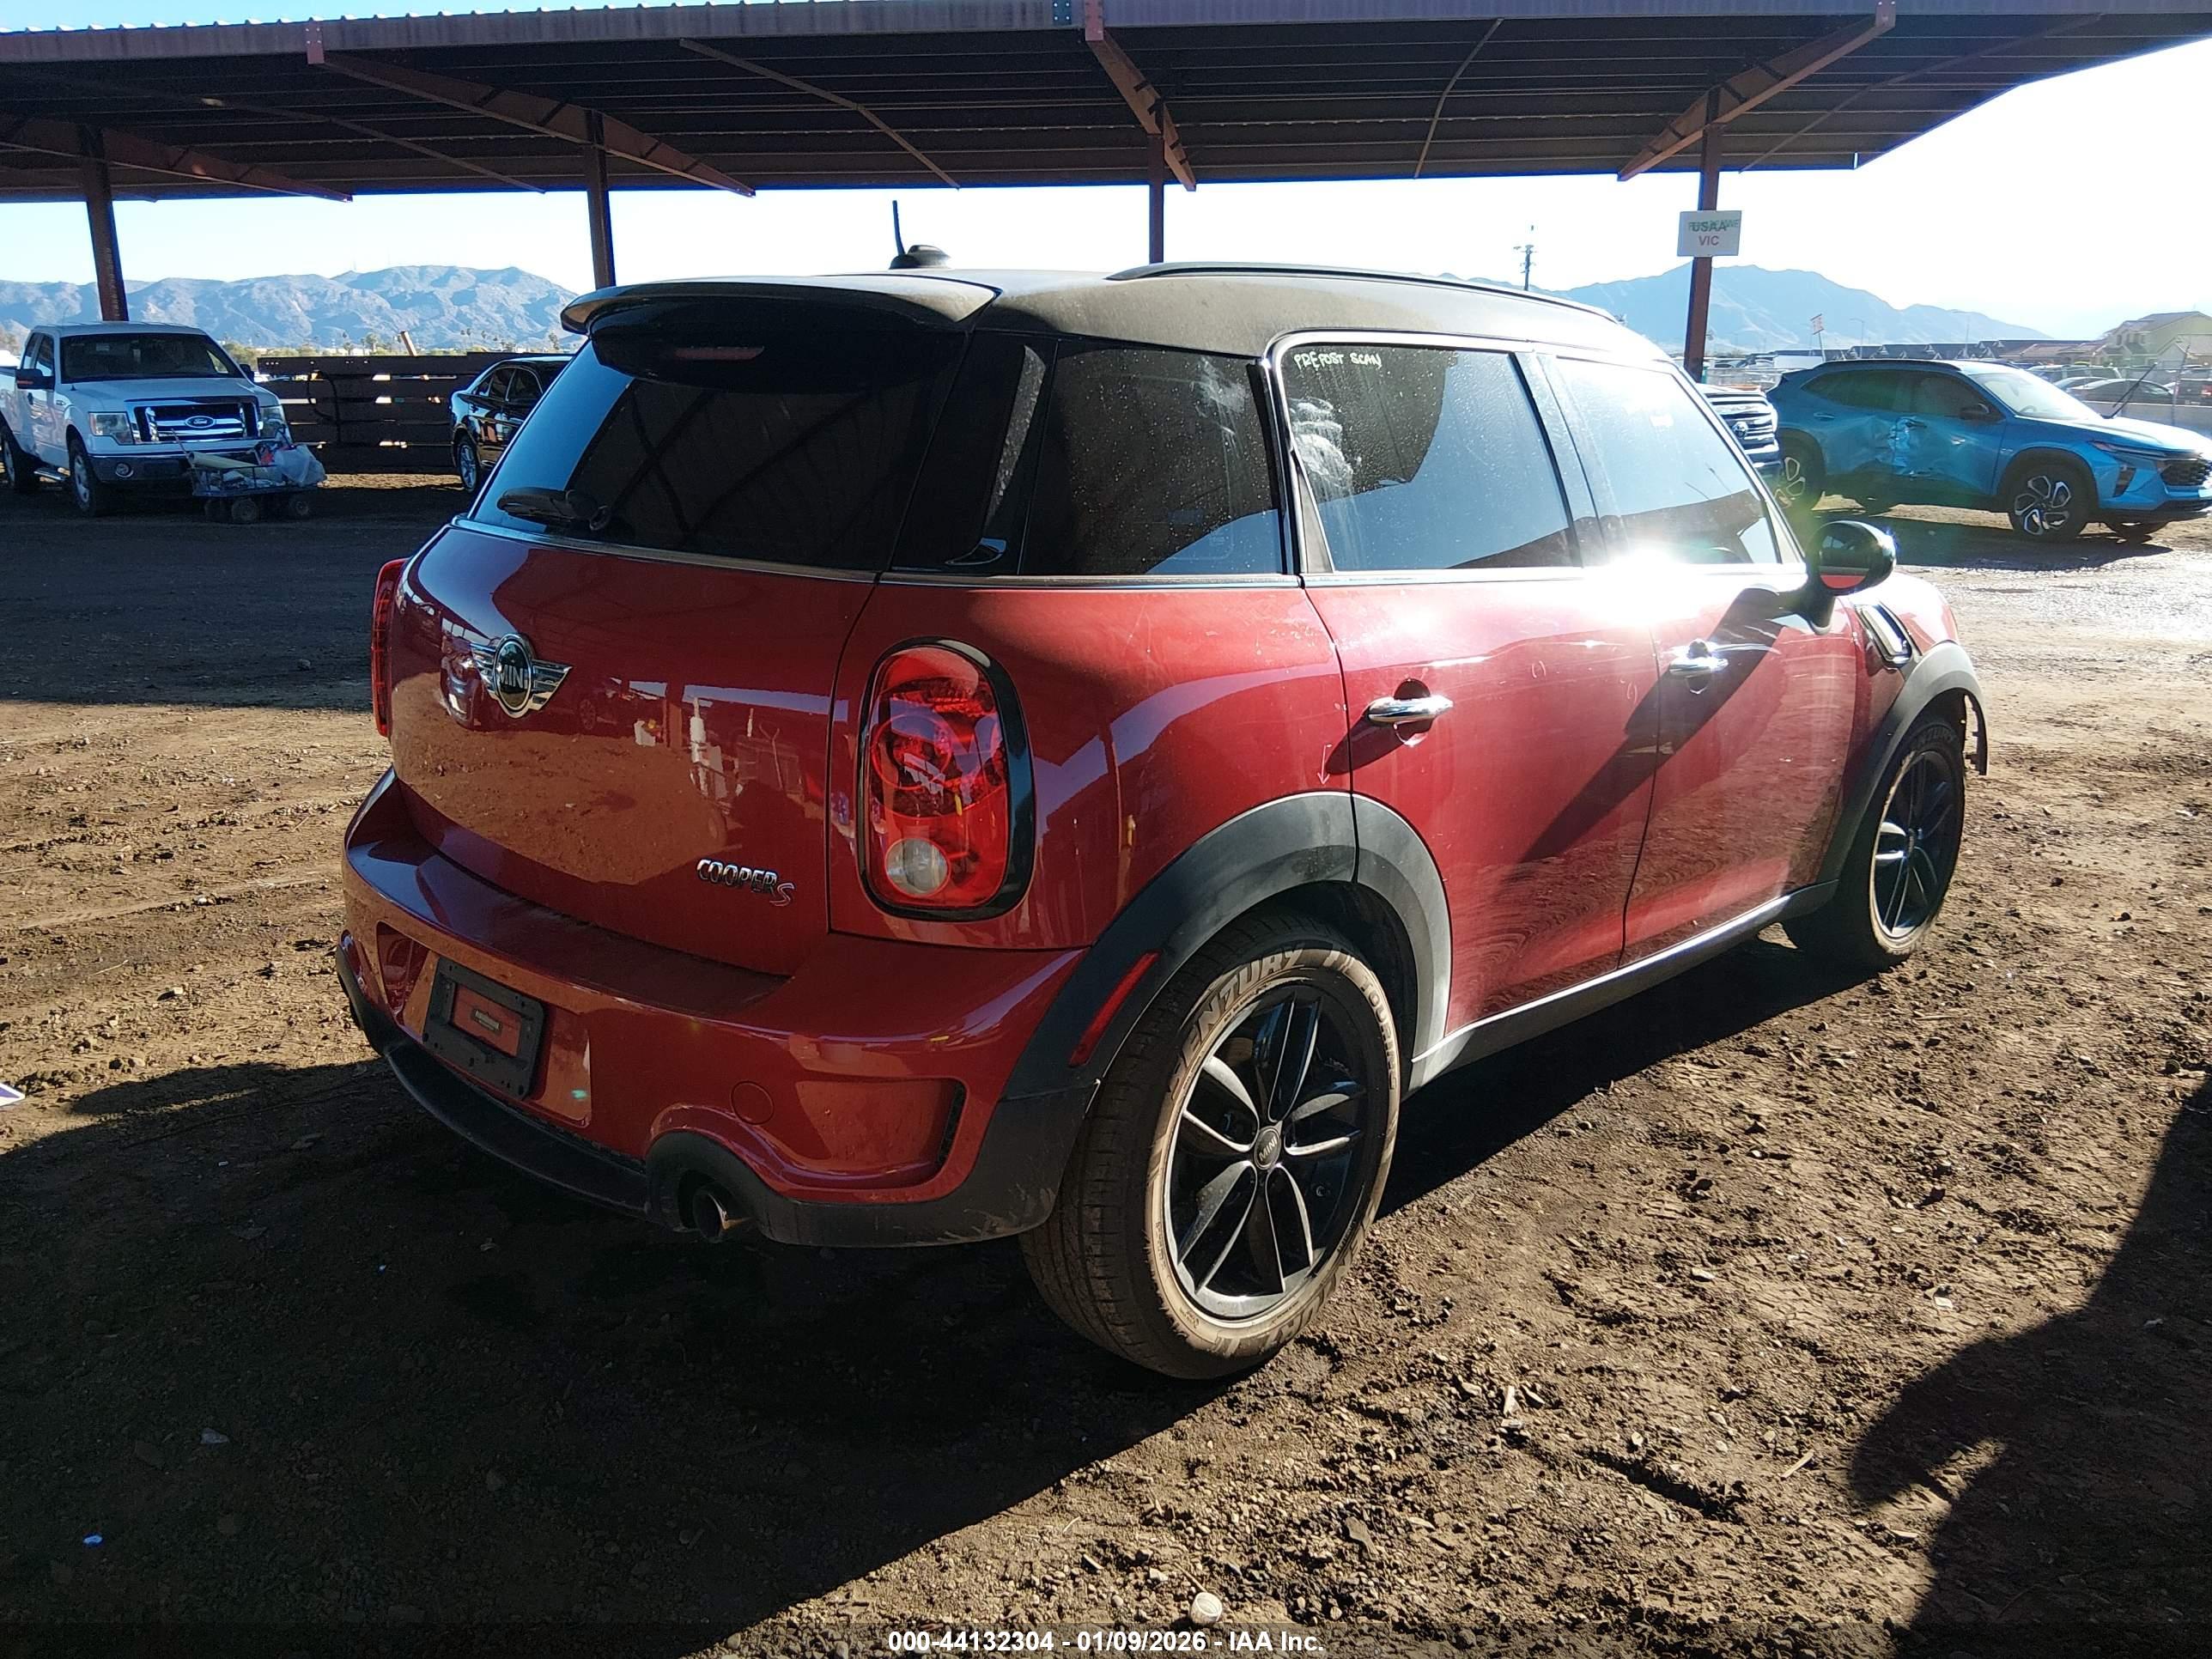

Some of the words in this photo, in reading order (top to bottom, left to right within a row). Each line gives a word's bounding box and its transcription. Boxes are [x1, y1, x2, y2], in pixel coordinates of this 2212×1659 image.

[1692, 221, 1727, 232] USAA
[1698, 235, 1719, 246] VIC
[1350, 352, 1382, 369] SCAN
[499, 664, 529, 690] MINI
[696, 859, 778, 897] COOPER
[769, 883, 796, 907] S
[1258, 1134, 1278, 1162] MINI
